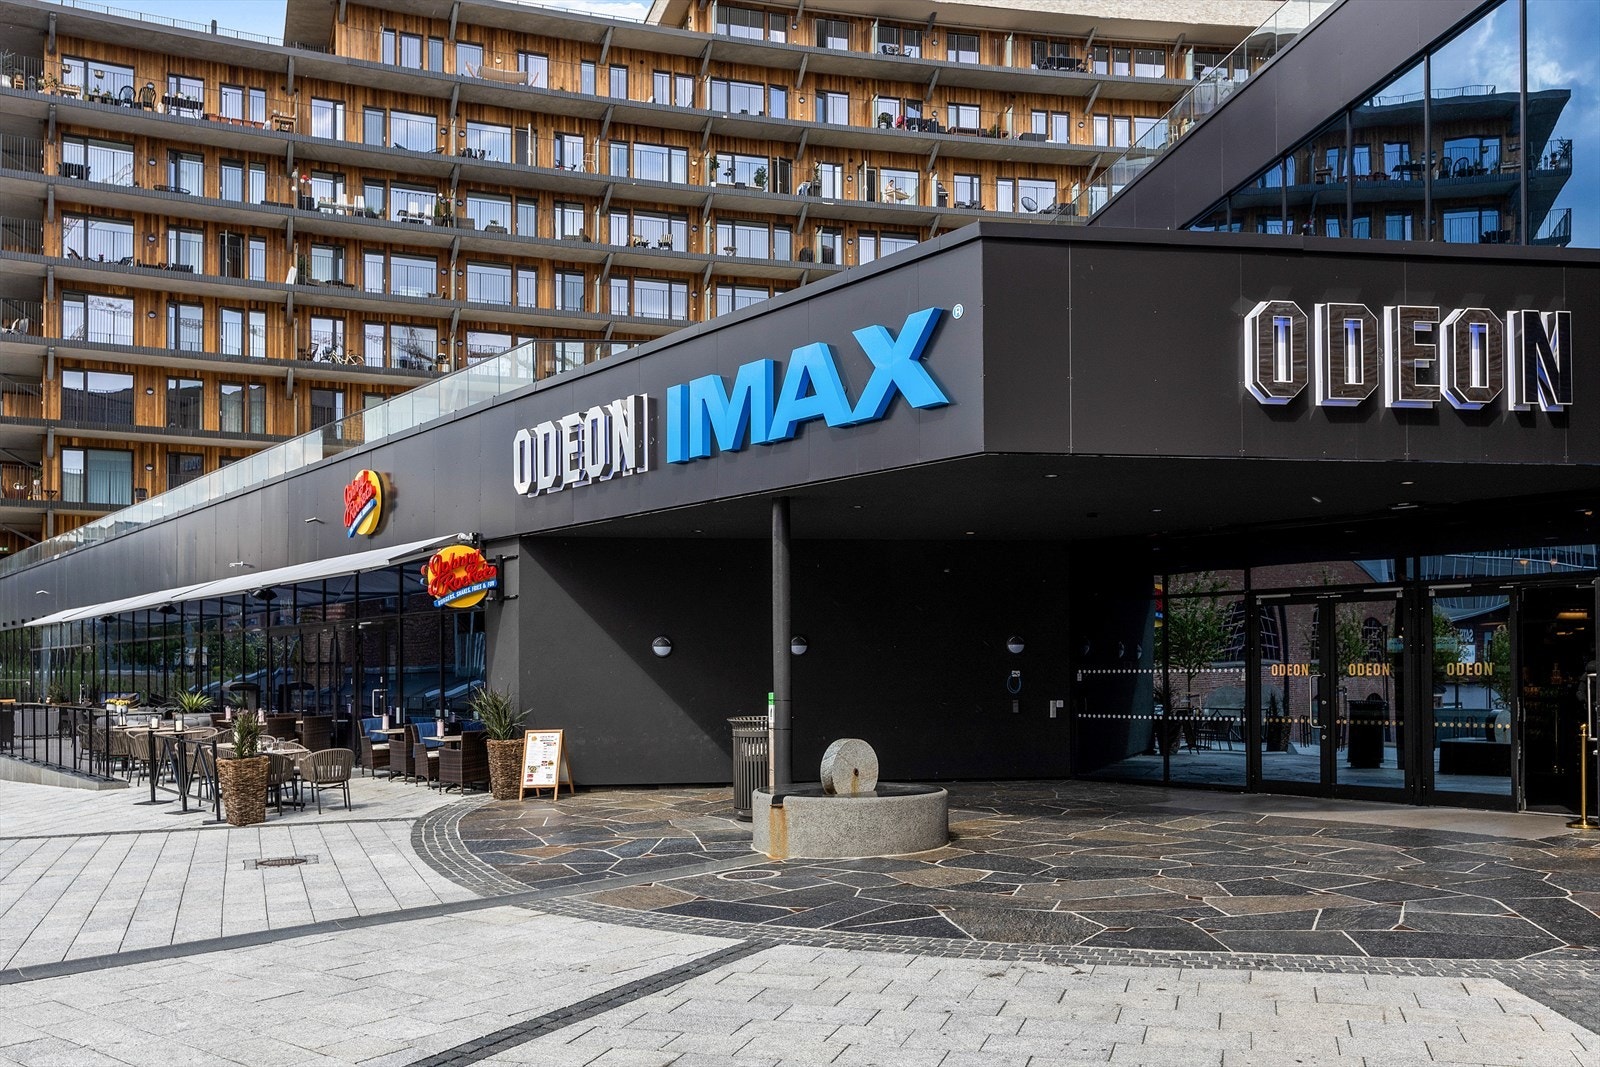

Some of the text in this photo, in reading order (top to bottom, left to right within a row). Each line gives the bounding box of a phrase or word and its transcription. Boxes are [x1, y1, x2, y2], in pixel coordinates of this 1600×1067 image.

[1244, 300, 1573, 411] ODEON
[513, 307, 949, 497] ODEON IMAX
[429, 549, 480, 576] Johnny
[428, 563, 497, 596] Rockets
[1271, 663, 1309, 676] ODEON
[1349, 663, 1390, 676] ODEON
[1446, 662, 1493, 676] ODEON
